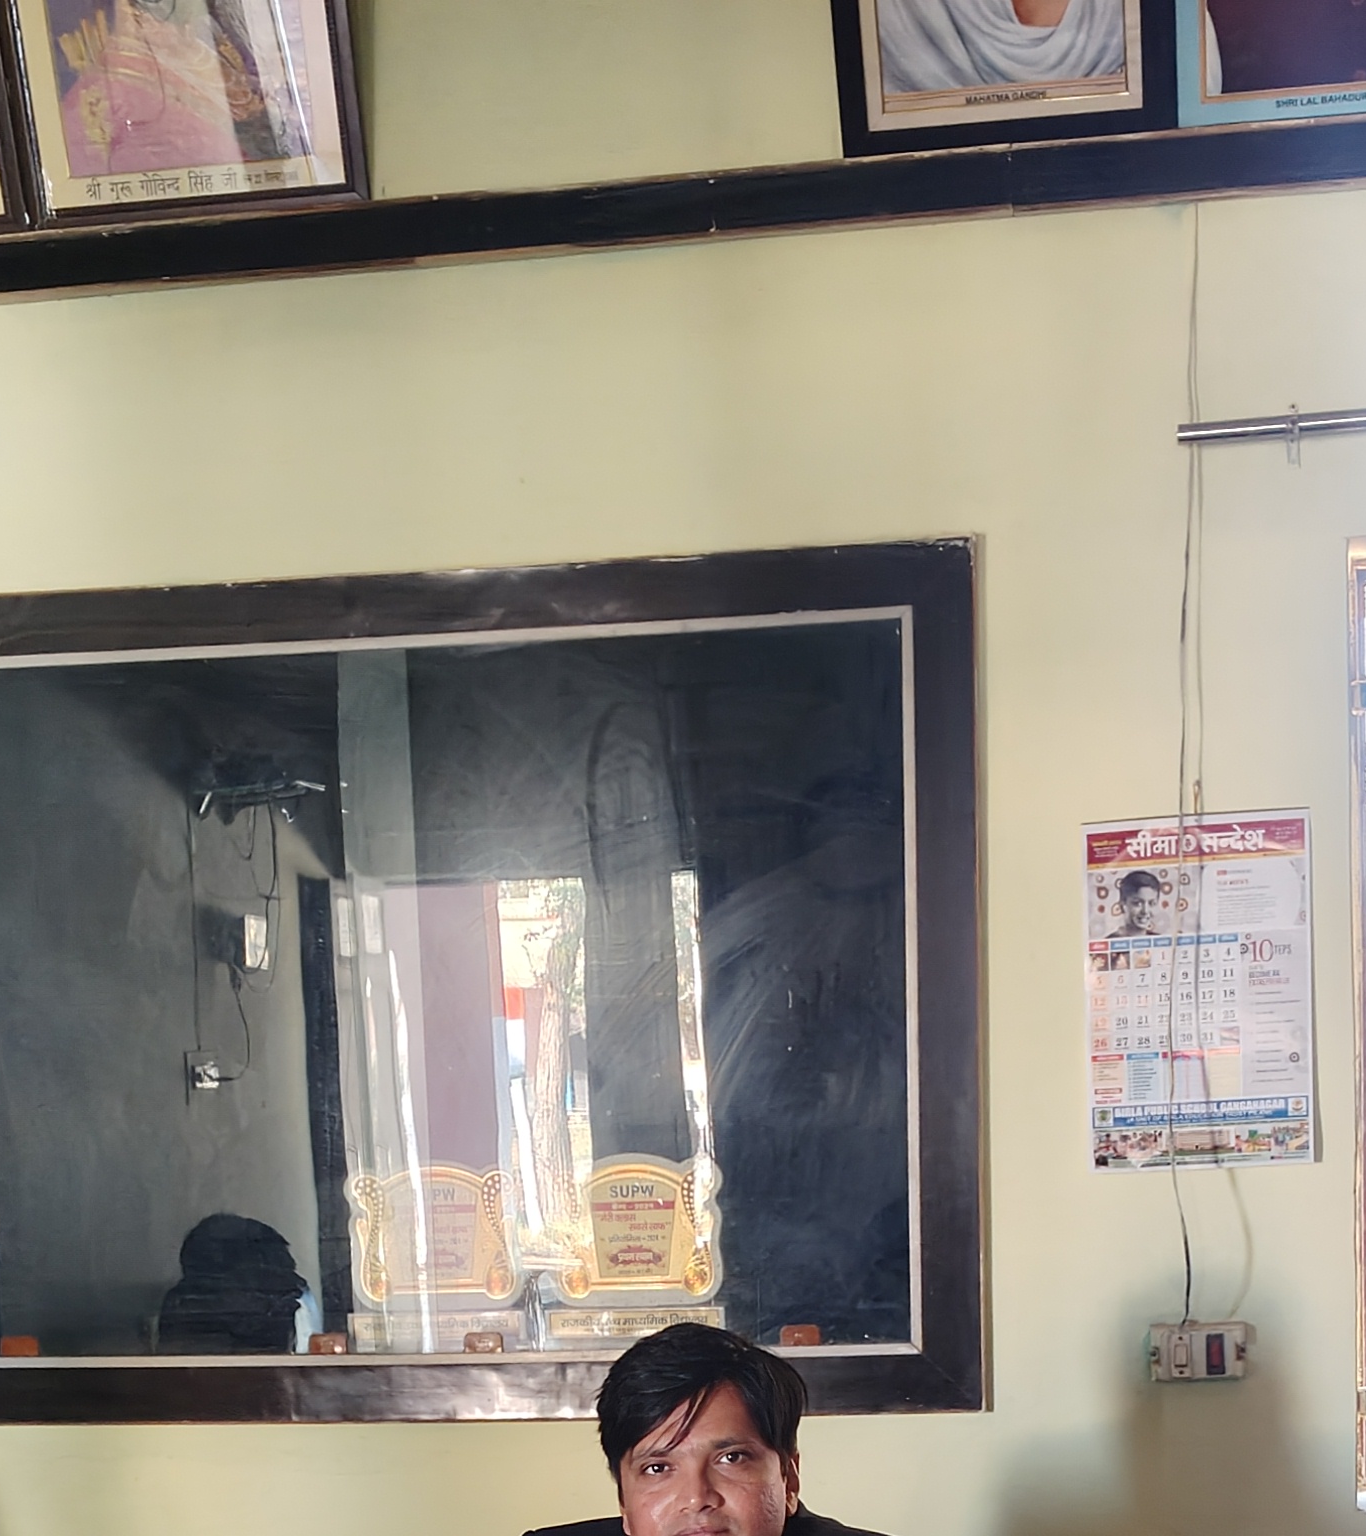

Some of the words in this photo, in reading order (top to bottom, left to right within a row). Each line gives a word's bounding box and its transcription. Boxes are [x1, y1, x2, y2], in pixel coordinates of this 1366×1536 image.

[1300, 95, 1319, 106] LAL
[86, 177, 101, 200] श्री
[139, 173, 181, 197] गोविन्द
[188, 170, 213, 194] सिंह
[221, 167, 239, 189] जी
[1125, 830, 1178, 858] सीमा
[1200, 825, 1266, 853] सन्देश
[1202, 948, 1210, 958] 3
[1225, 947, 1232, 956] 4
[1248, 939, 1274, 962] 10
[1138, 973, 1146, 983] 7
[1160, 972, 1167, 981] 8
[1181, 971, 1189, 980] 9
[1201, 969, 1214, 979] 10
[1222, 968, 1234, 978] 11
[1158, 993, 1171, 1002] 15
[1180, 992, 1193, 1001] 16
[1201, 990, 1214, 1000] 17
[1223, 989, 1235, 999] 18
[1115, 1017, 1128, 1026] 20
[1137, 1015, 1149, 1025] 21
[1094, 1038, 1107, 1048] 26
[1115, 1037, 1129, 1047] 27
[1137, 1036, 1150, 1045] 28
[1144, 1105, 1178, 1116] PUBLC
[609, 1183, 654, 1199] SUPW
